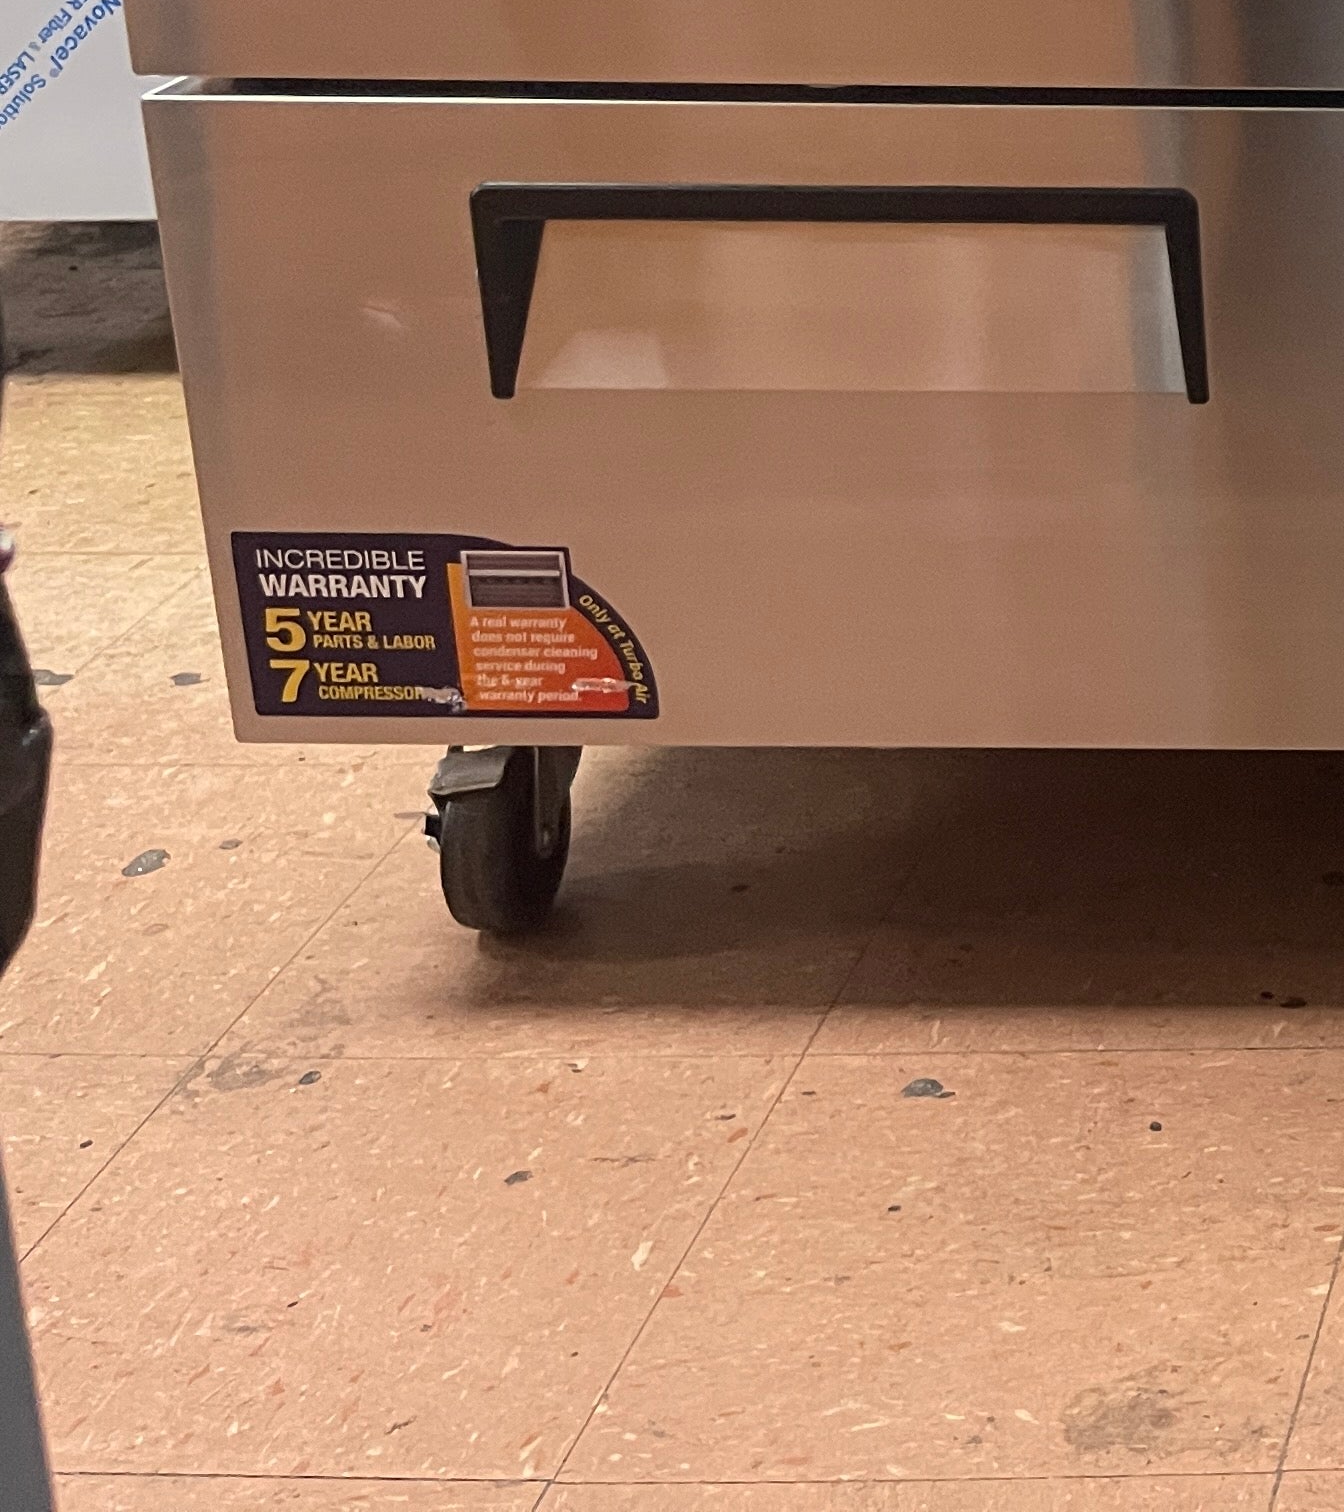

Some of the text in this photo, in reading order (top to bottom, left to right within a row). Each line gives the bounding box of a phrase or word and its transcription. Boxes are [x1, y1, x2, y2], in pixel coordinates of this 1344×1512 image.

[37, 7, 73, 44] Fiber
[255, 548, 426, 571] INCREDIBLE
[258, 573, 427, 599] WARRANTY
[264, 607, 373, 653] 5 YEAR
[470, 615, 568, 632] A real warranty
[313, 634, 437, 651] PARTS & LABOR
[471, 631, 575, 647] does not require
[473, 645, 598, 660] condenser cleaning
[579, 594, 651, 705] Only at Turbo Air
[475, 661, 566, 675] service during
[269, 658, 379, 703] 7 YEAR
[476, 673, 500, 687] the
[479, 689, 536, 703] warranty
